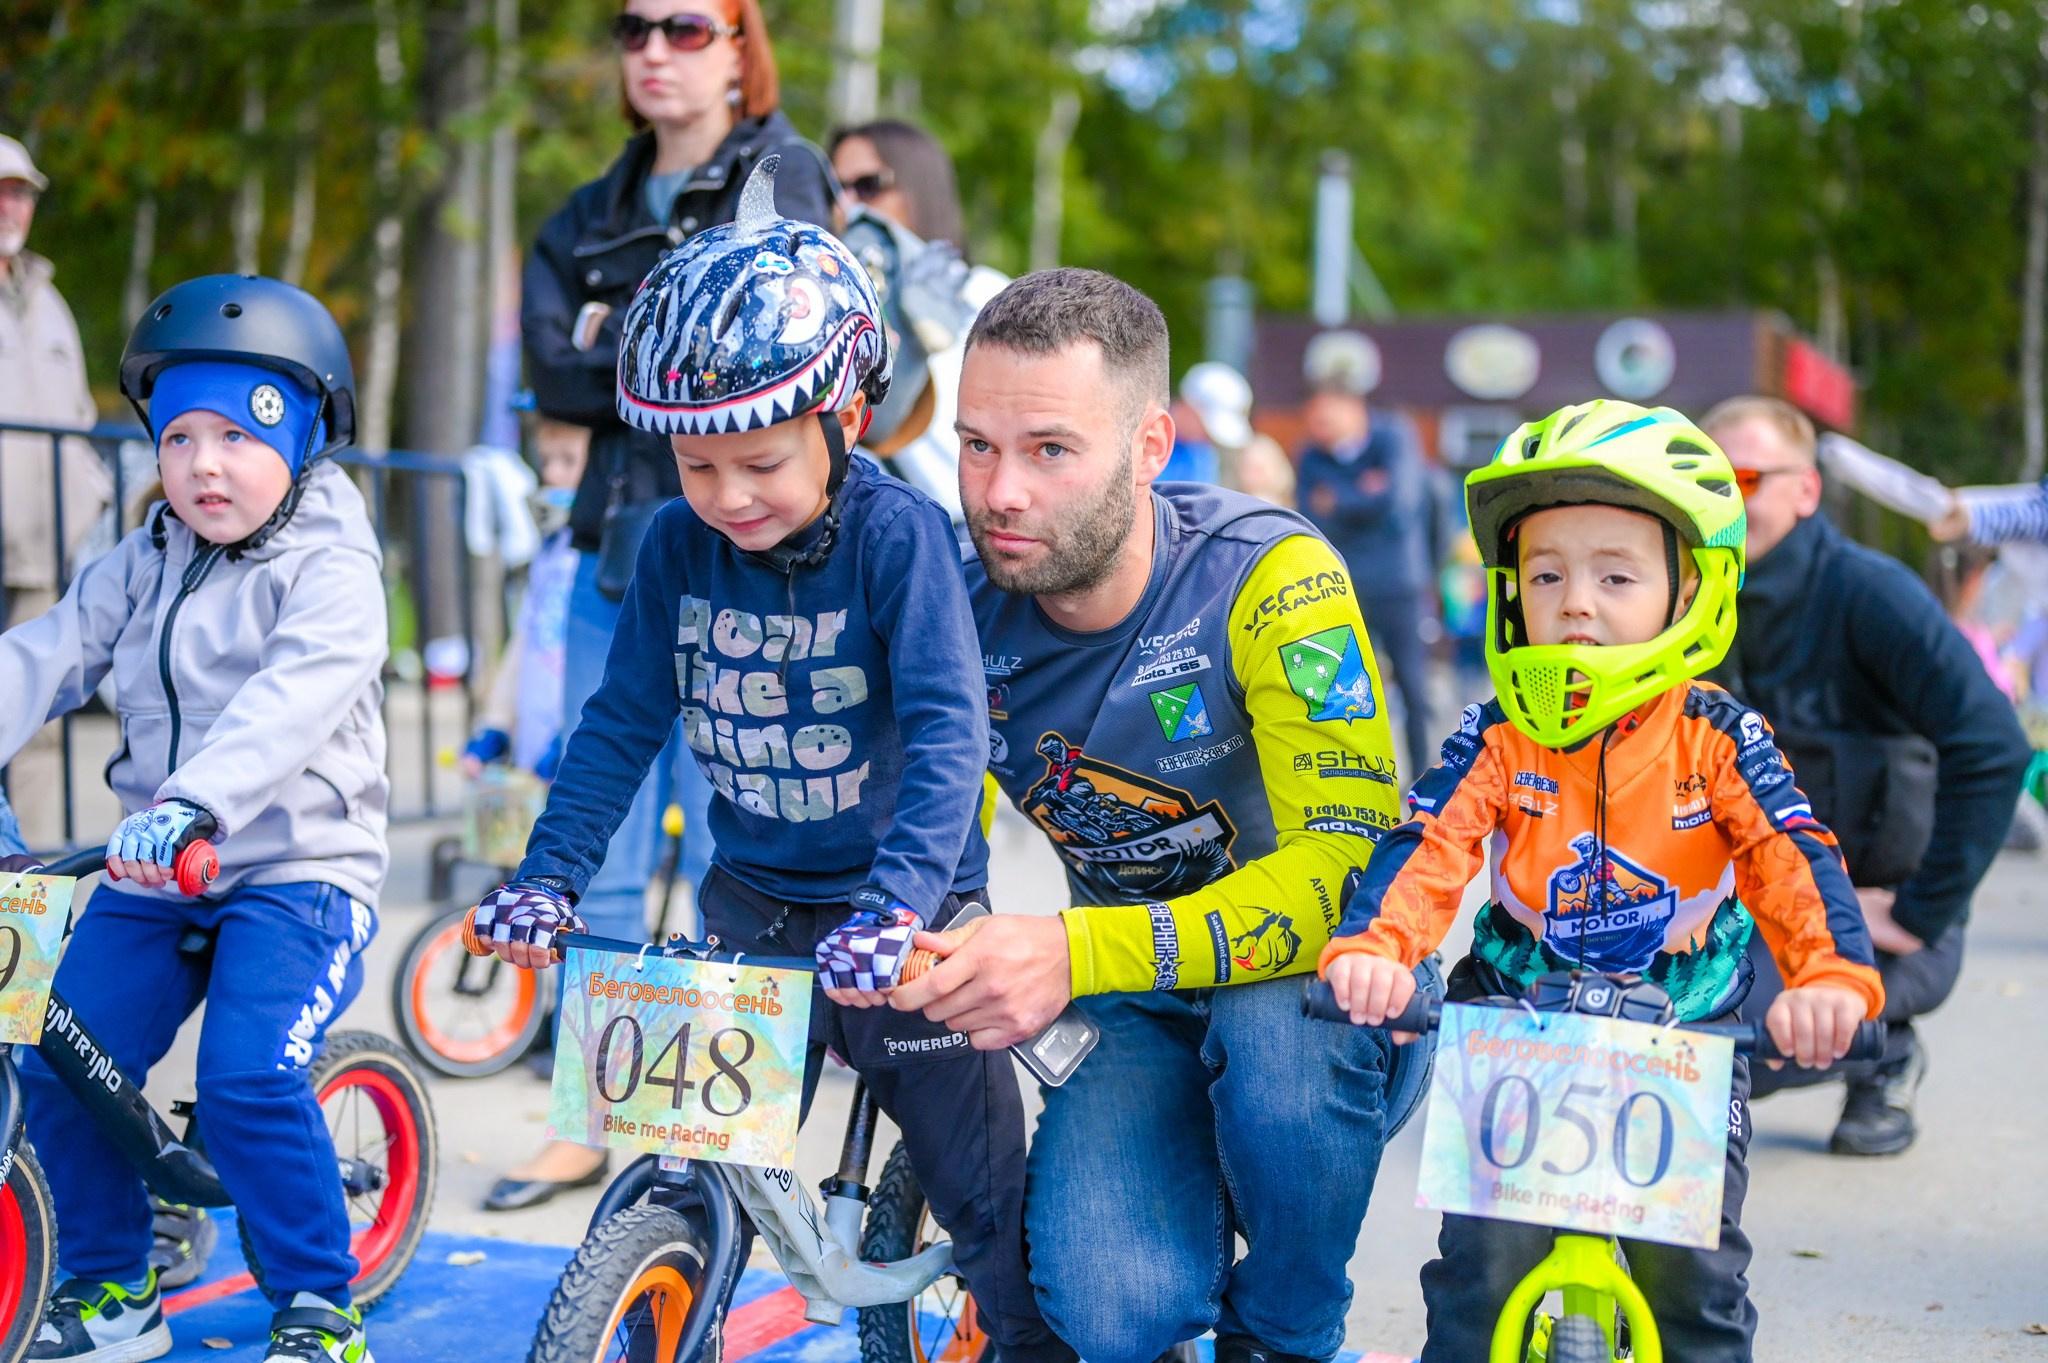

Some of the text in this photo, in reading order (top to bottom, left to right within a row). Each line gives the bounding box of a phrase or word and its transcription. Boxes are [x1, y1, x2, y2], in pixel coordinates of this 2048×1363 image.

[982, 654, 1024, 670] HULZ
[1172, 650, 1183, 662] 25
[1184, 646, 1197, 659] 30
[809, 665, 869, 715] a
[1085, 836, 1176, 859] MOTOR
[1146, 902, 1180, 960] ЕВЕРНАЯ
[1571, 910, 1640, 934] MOTOR
[588, 971, 784, 1016] Беговелоосень
[276, 984, 335, 1071] PAR
[596, 1014, 756, 1118] 048
[1467, 1030, 1702, 1083] Беговелоосень
[602, 1114, 730, 1151] Bike me Racing
[1479, 1074, 1675, 1188] 050
[1490, 1182, 1646, 1224] Bike me Racing
